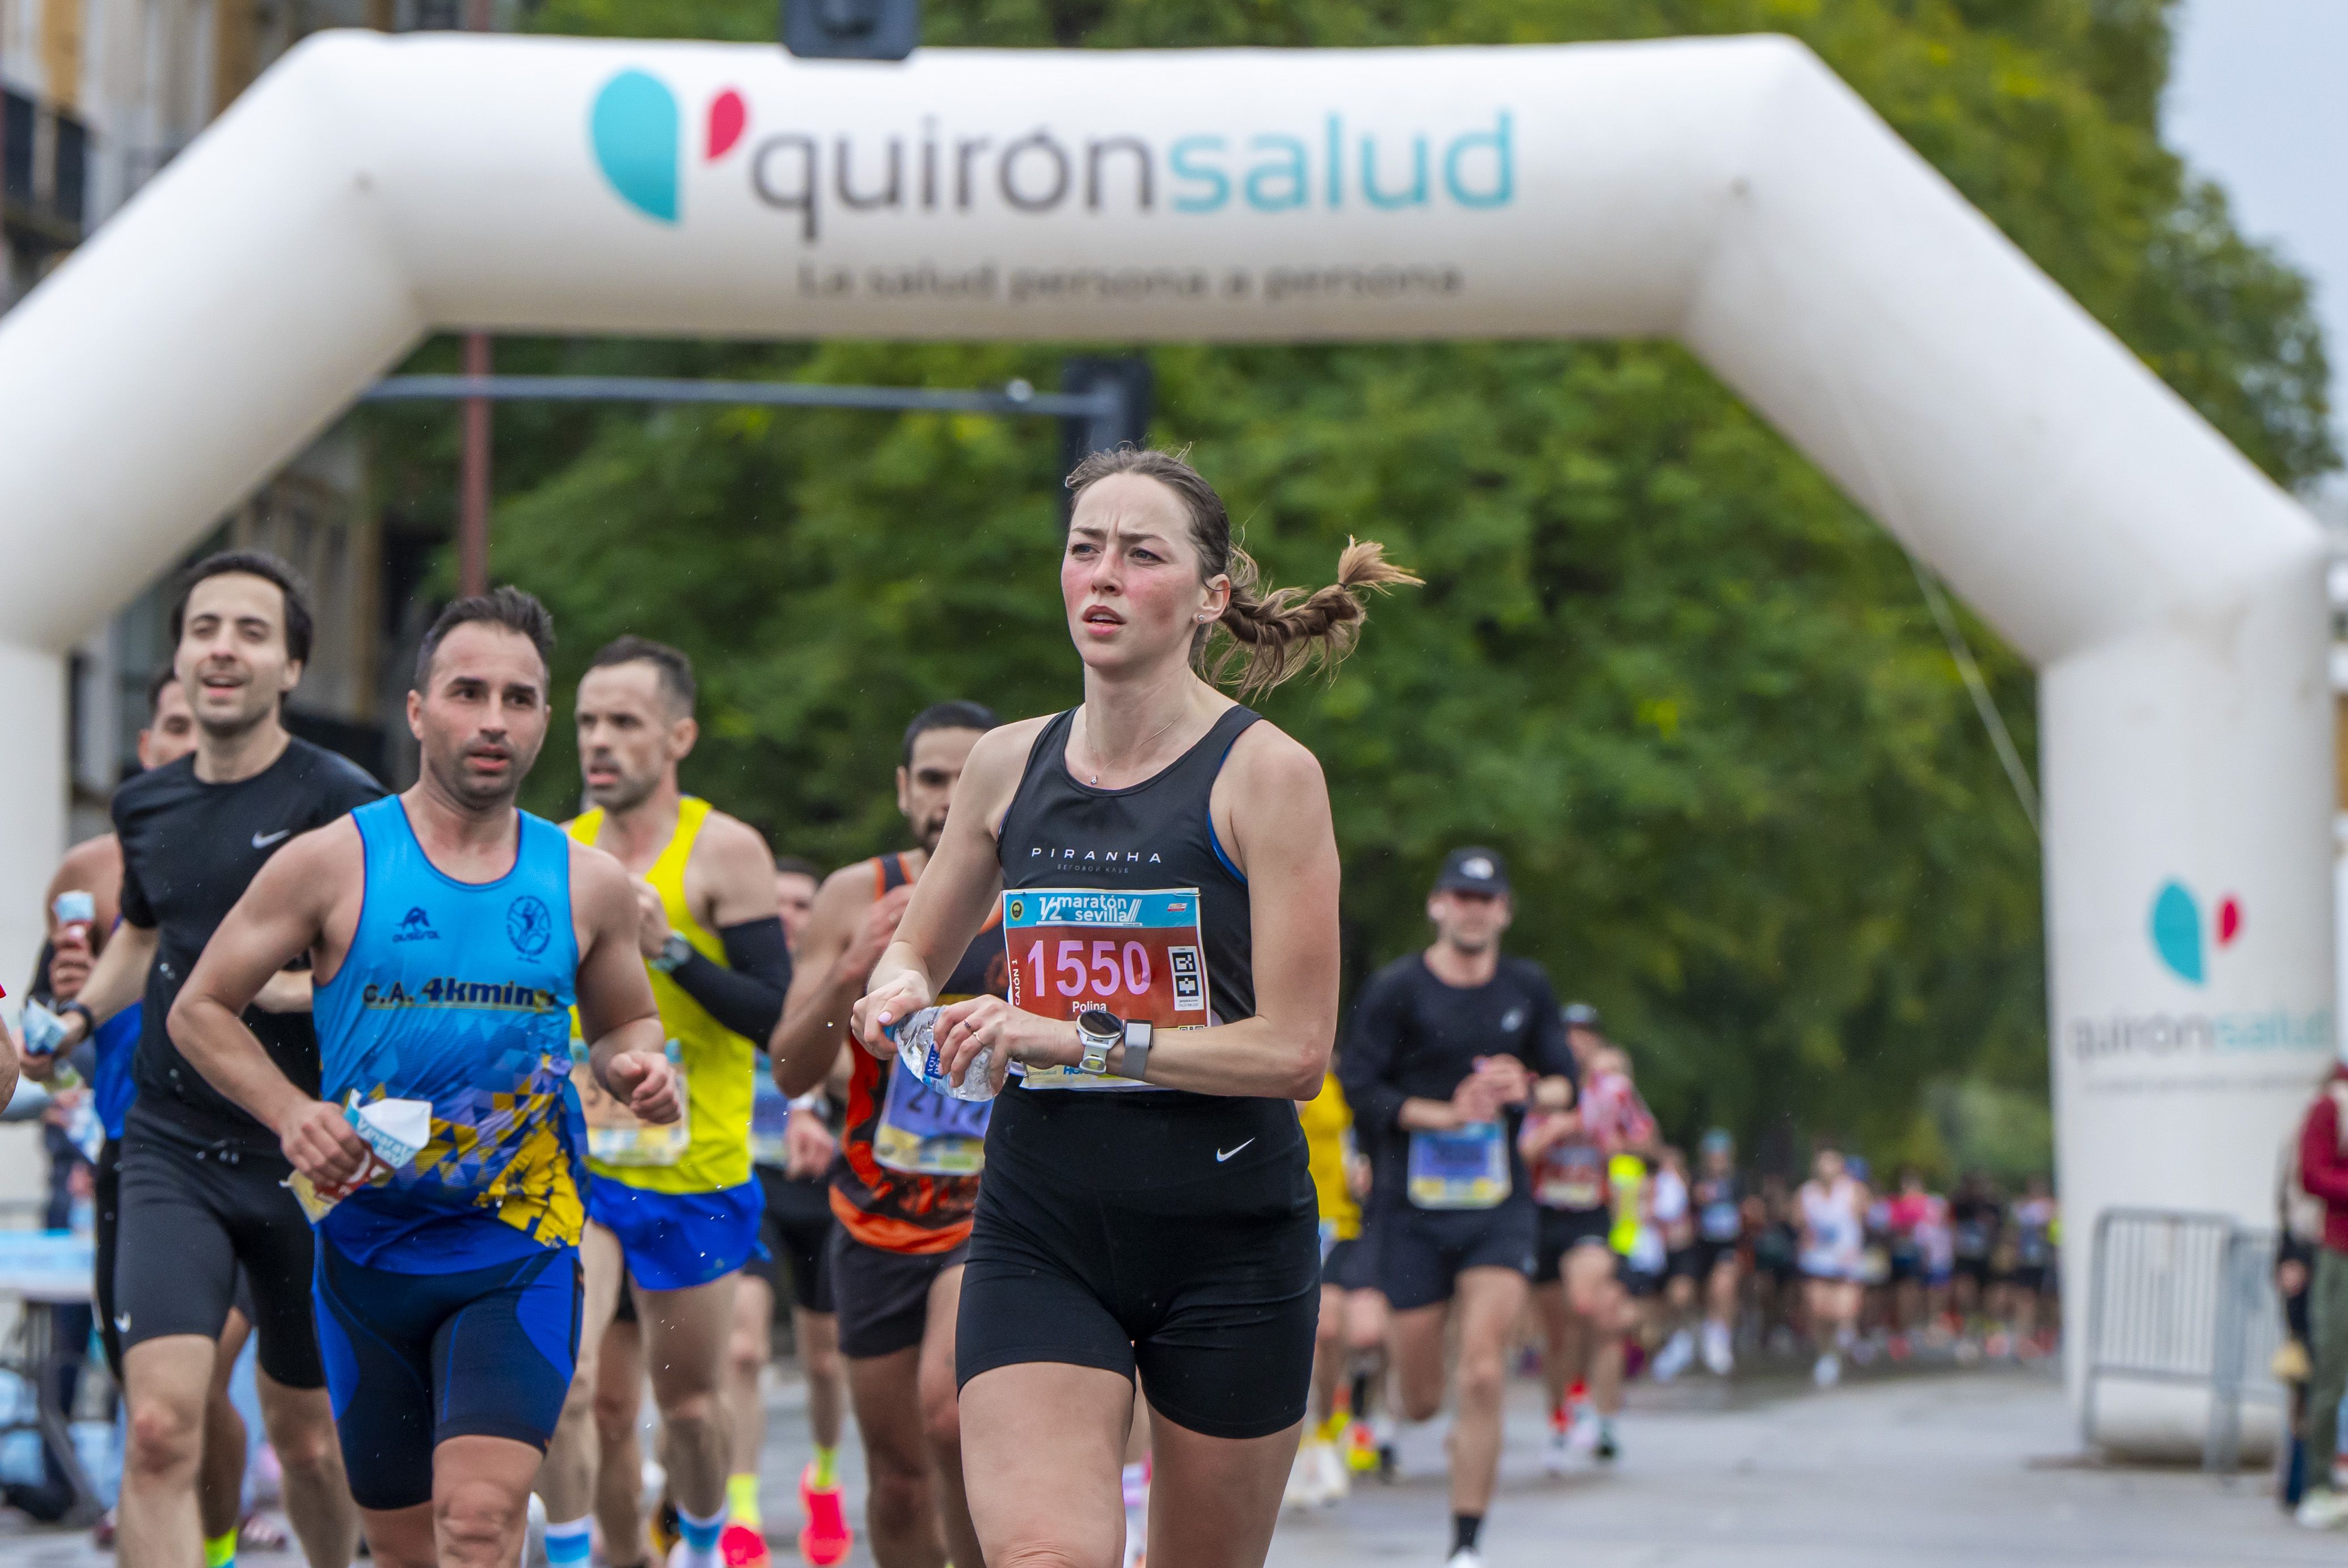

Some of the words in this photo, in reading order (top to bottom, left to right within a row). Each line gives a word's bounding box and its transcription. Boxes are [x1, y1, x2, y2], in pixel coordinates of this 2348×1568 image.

[750, 107, 1517, 243] quirónsalud
[796, 260, 855, 298] La
[863, 256, 999, 299] salud
[1010, 263, 1209, 306] persona
[1221, 265, 1251, 298] a
[1261, 263, 1464, 306] persona
[1031, 847, 1162, 864] PIRANHA
[1057, 895, 1127, 908] maratón
[1075, 907, 1127, 922] sevilla
[1027, 940, 1152, 997] 1550
[1072, 1000, 1107, 1013] Polina
